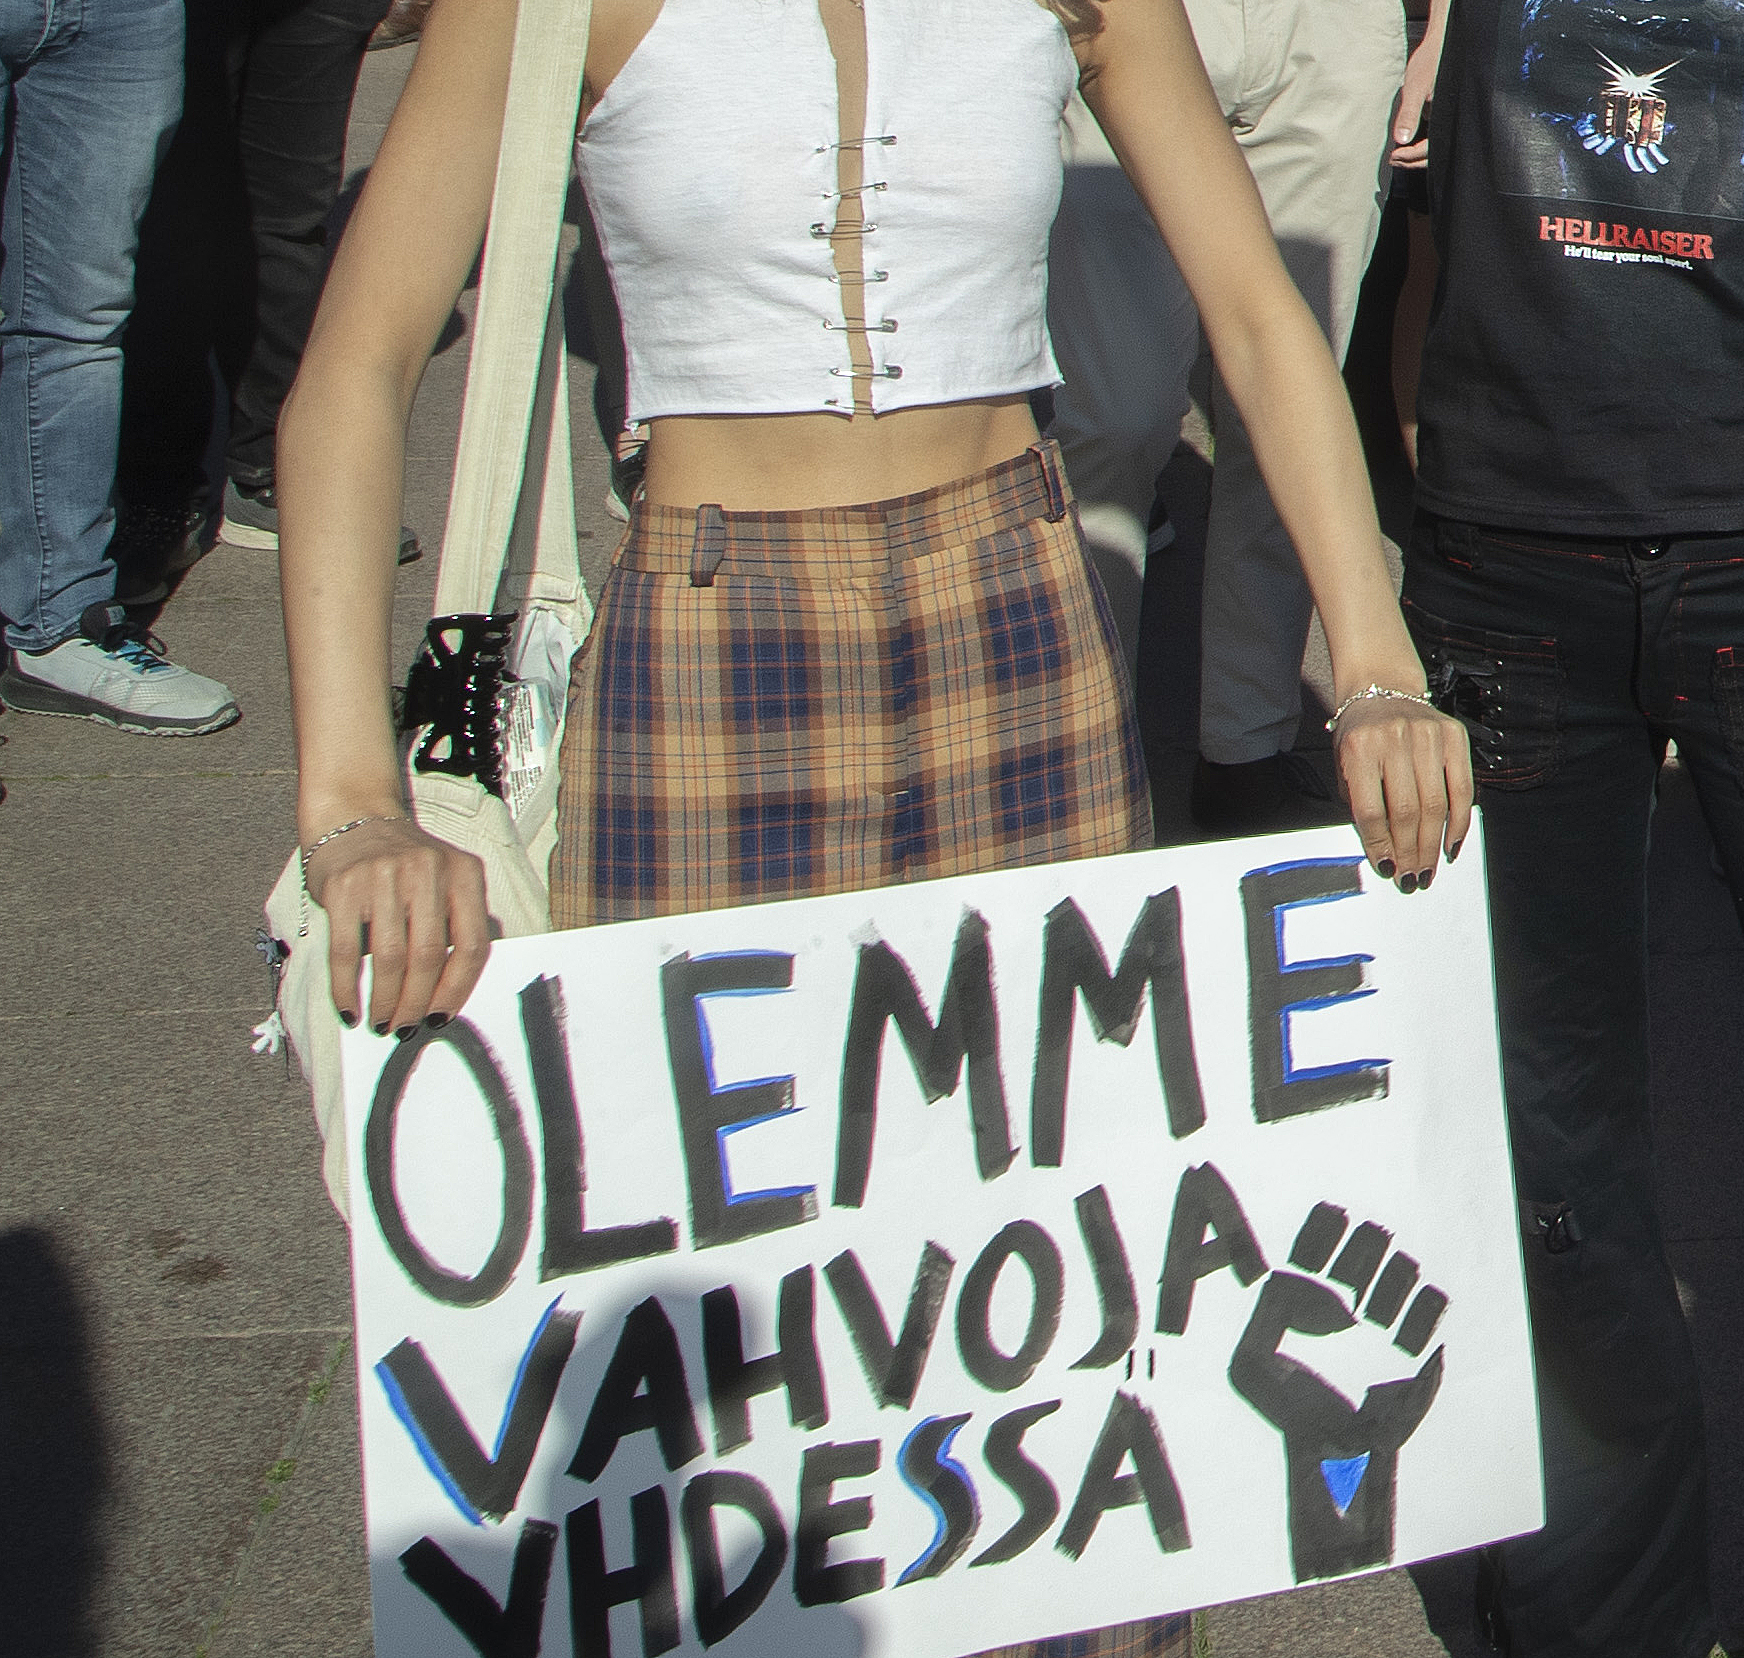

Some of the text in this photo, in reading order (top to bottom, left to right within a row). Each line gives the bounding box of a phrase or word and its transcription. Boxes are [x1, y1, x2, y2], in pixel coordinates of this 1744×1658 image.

[1539, 215, 1714, 259] HELLRAISER
[1564, 245, 1592, 259] He'll
[1592, 249, 1615, 262] tear
[1616, 252, 1641, 264] your
[1641, 253, 1664, 264] soul
[364, 855, 1392, 1308] OLEMME
[375, 1161, 1272, 1526] VAHVOJA
